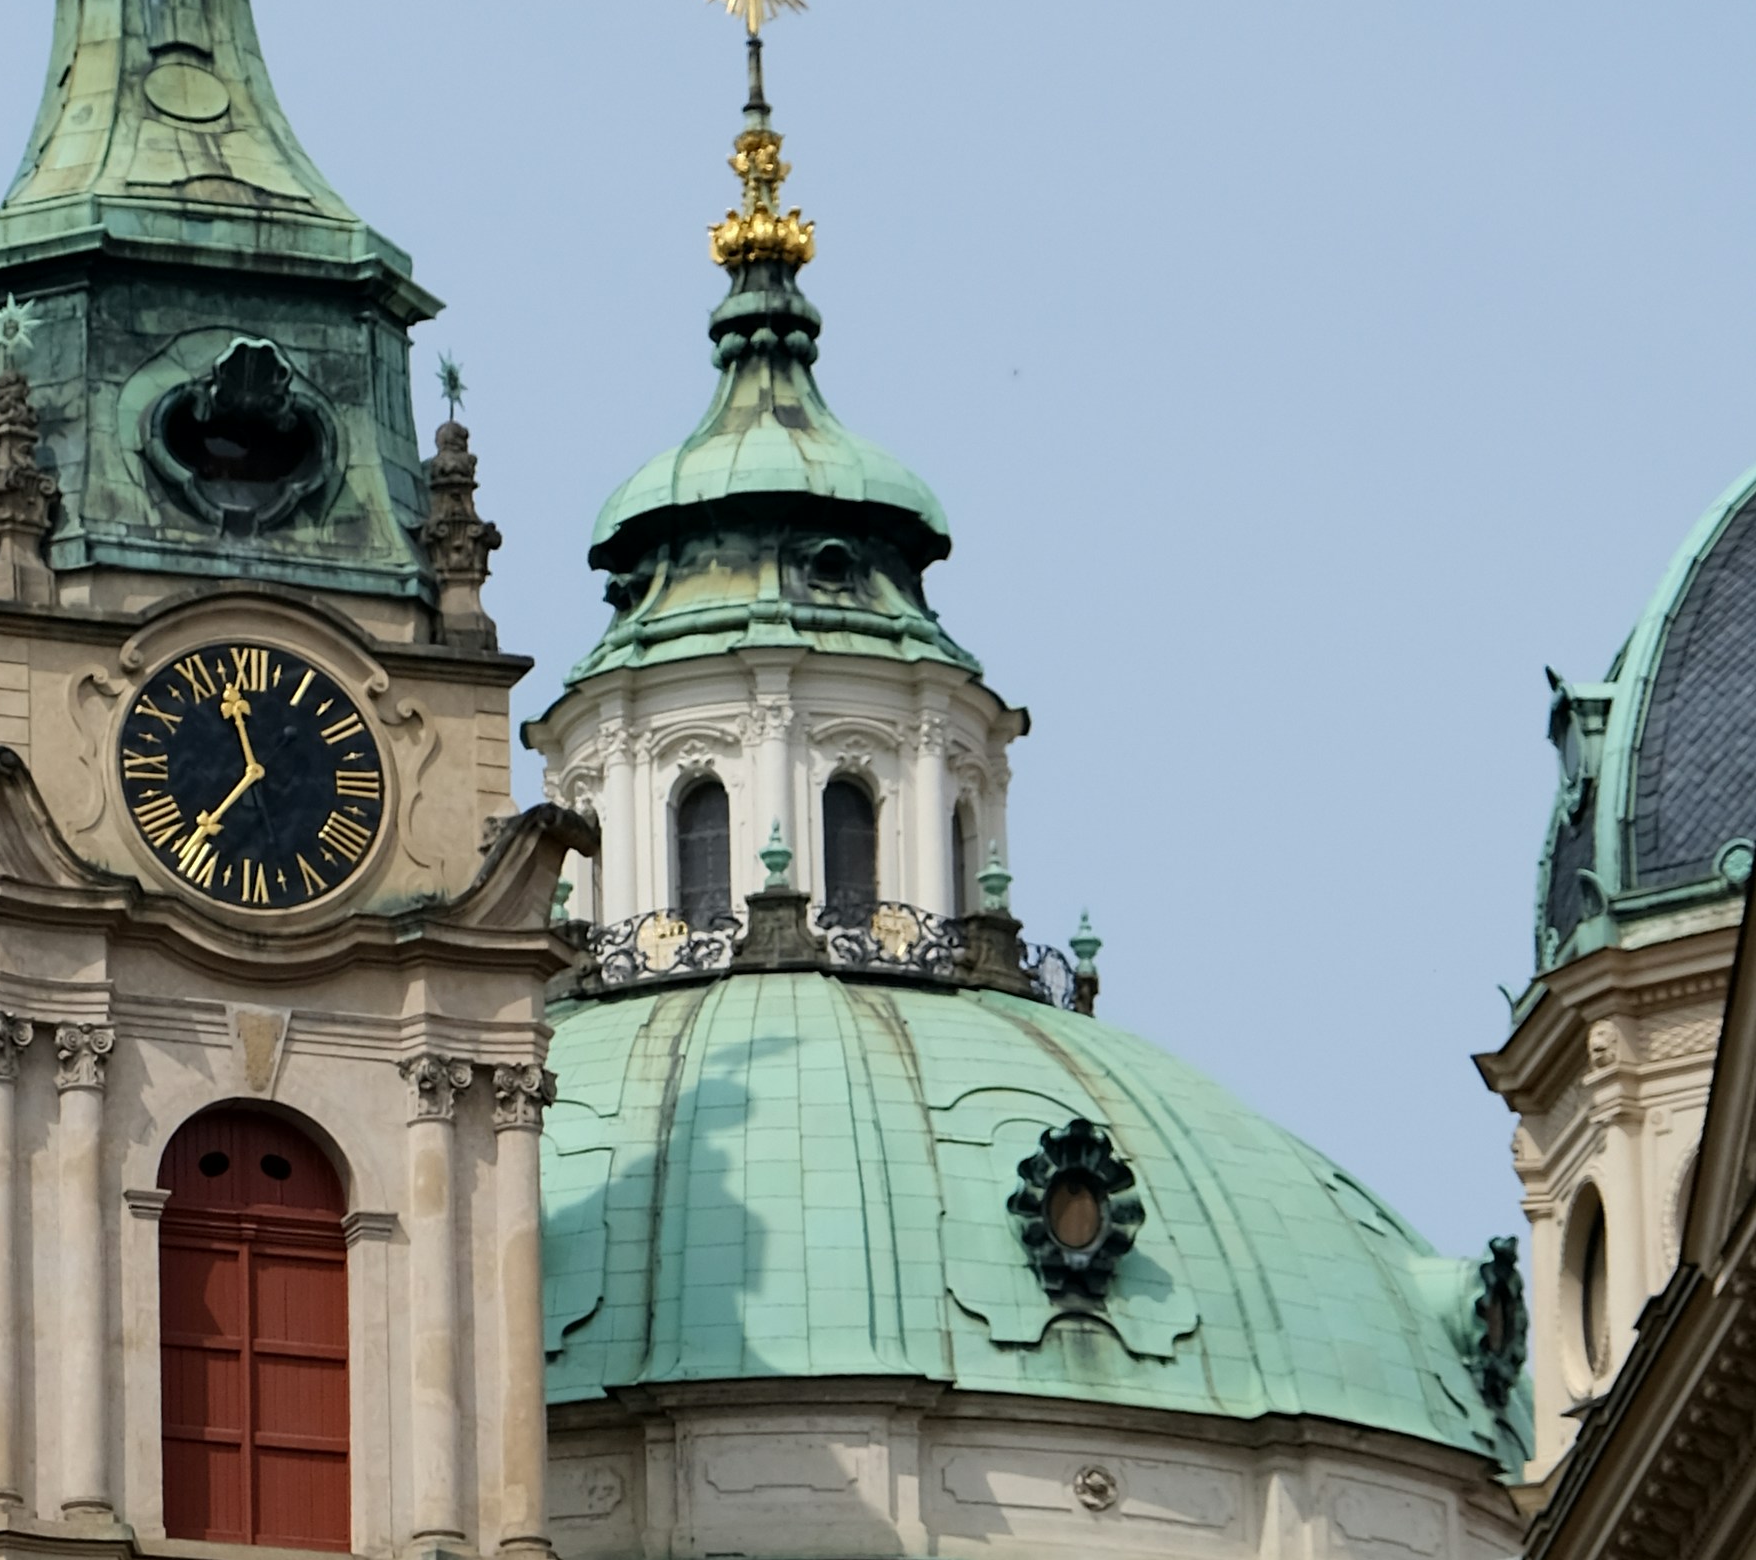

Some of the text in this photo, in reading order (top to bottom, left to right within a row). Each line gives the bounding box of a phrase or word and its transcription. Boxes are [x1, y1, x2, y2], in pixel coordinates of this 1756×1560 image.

[173, 653, 218, 705] XI
[230, 647, 270, 692] XII
[289, 668, 317, 707] I
[134, 694, 183, 735] X
[320, 712, 365, 745] II
[123, 748, 169, 780] IX
[335, 769, 380, 800] III
[133, 795, 186, 848] VIII
[318, 811, 372, 863] IIII
[241, 858, 271, 904] VI
[296, 852, 329, 897] V
